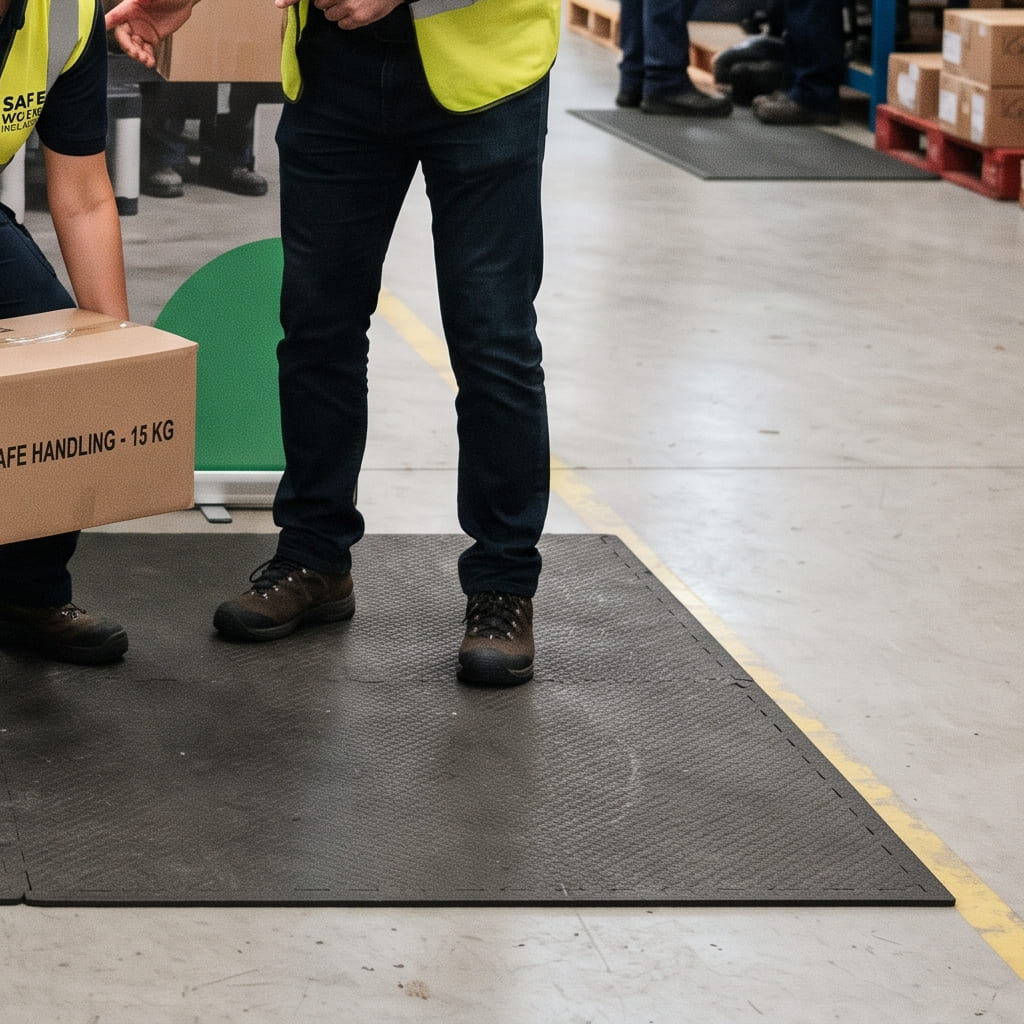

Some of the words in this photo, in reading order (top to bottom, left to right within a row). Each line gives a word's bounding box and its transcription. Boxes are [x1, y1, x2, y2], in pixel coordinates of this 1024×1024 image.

[3, 91, 46, 112] SAFE
[32, 429, 115, 463] HANDLING
[131, 424, 147, 446] 15
[152, 419, 174, 443] KG
